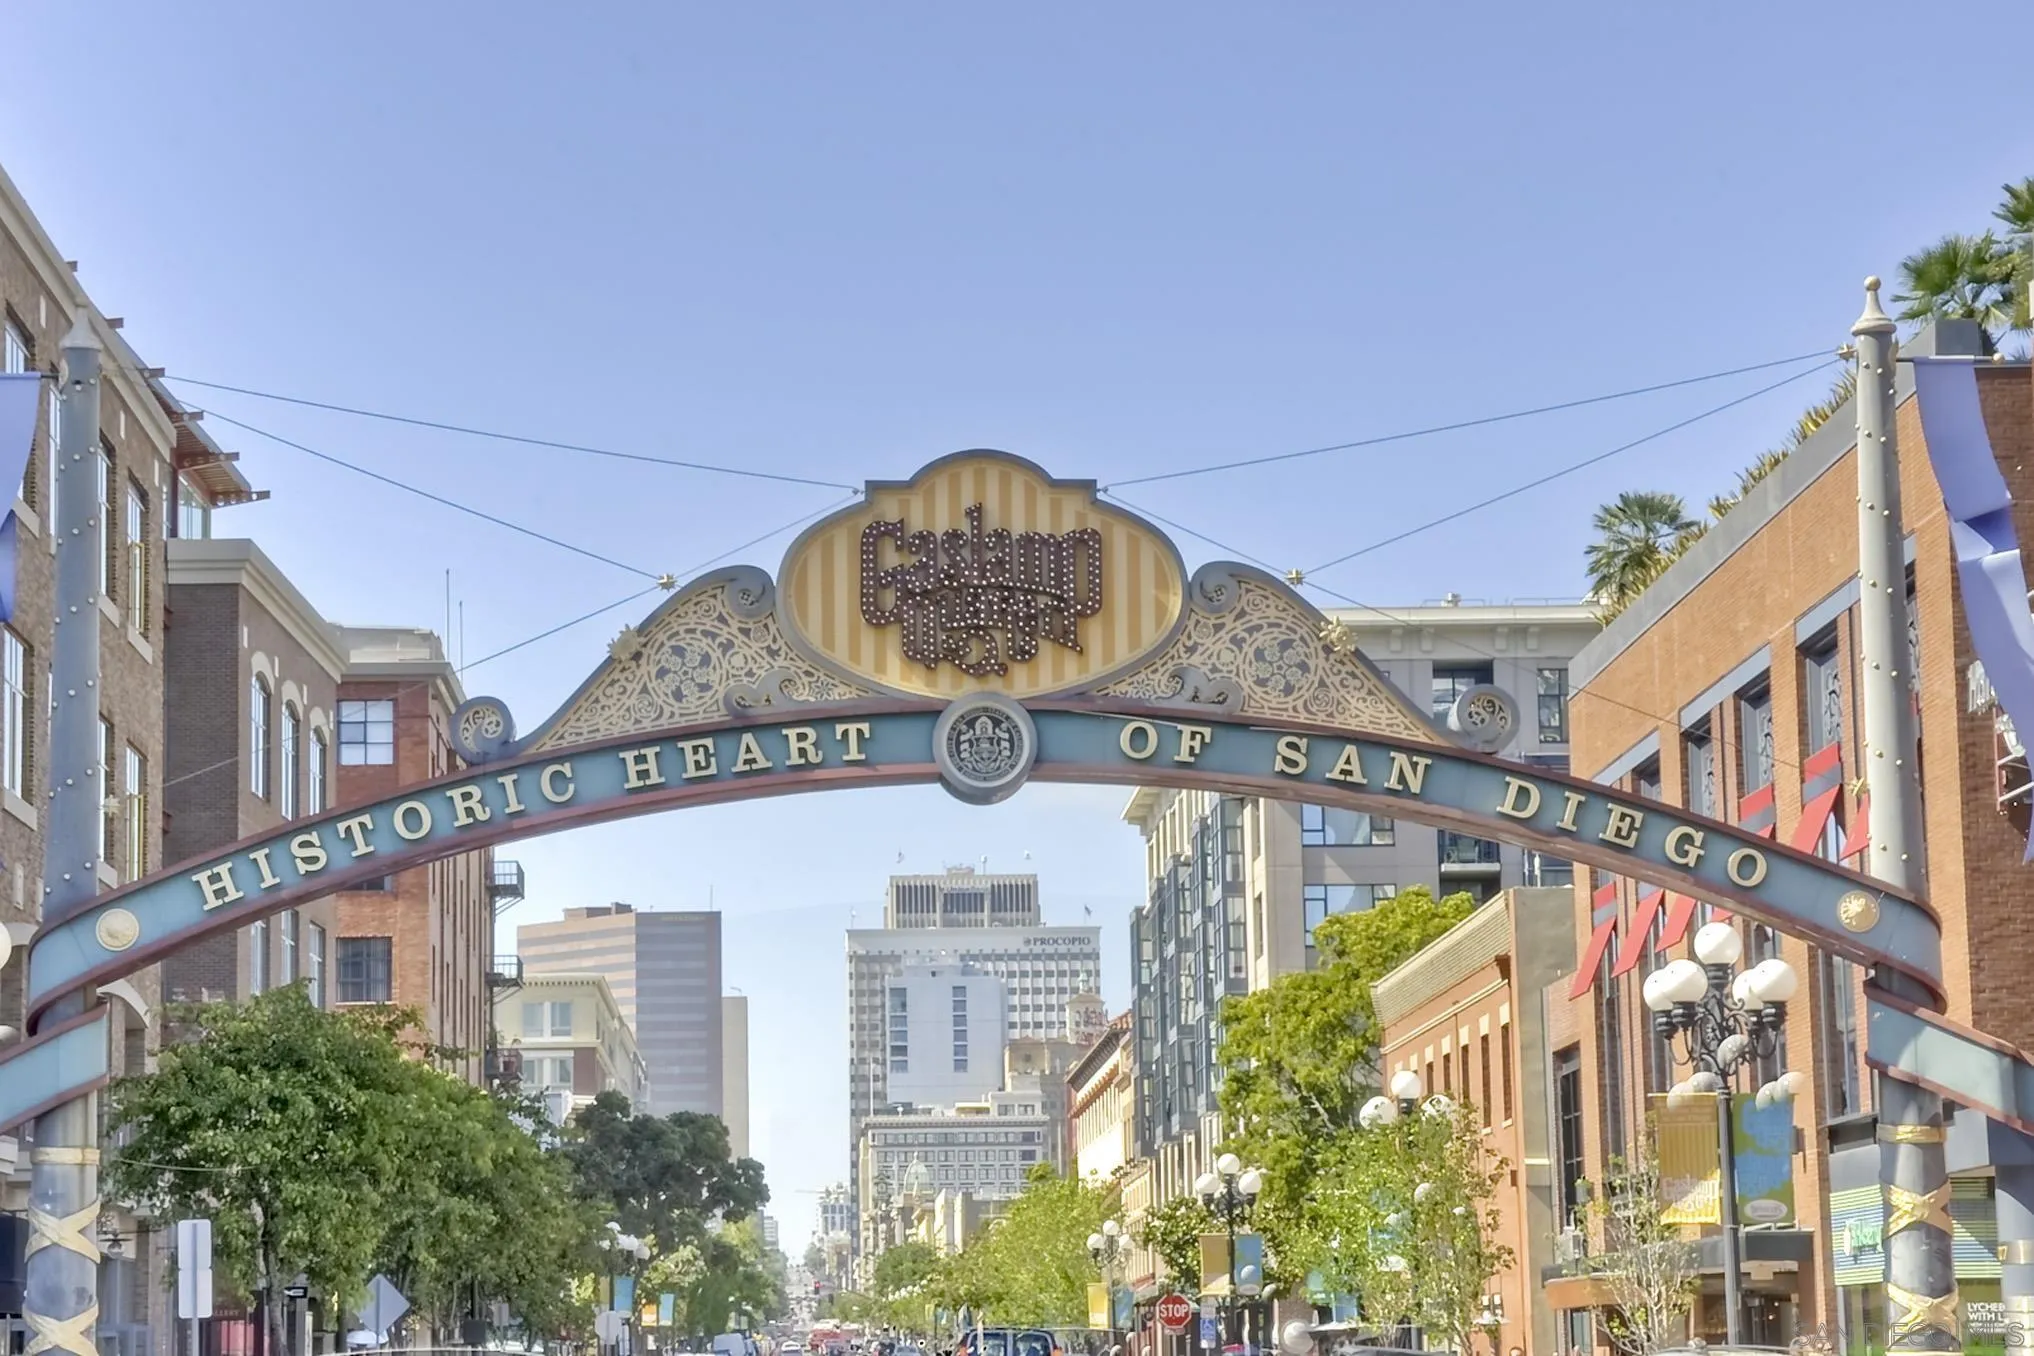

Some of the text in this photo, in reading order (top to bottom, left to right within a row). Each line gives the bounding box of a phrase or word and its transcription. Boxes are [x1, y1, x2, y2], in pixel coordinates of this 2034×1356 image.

[191, 762, 575, 911] HISTORIC
[618, 722, 871, 789] HEART
[1119, 721, 1212, 763] OF
[1274, 735, 1432, 795] SAN
[1496, 776, 1768, 888] DIEGO
[1032, 935, 1091, 946] PROCOPIO
[1160, 1303, 1189, 1317] STOP
[1967, 1312, 1996, 1321] WITH
